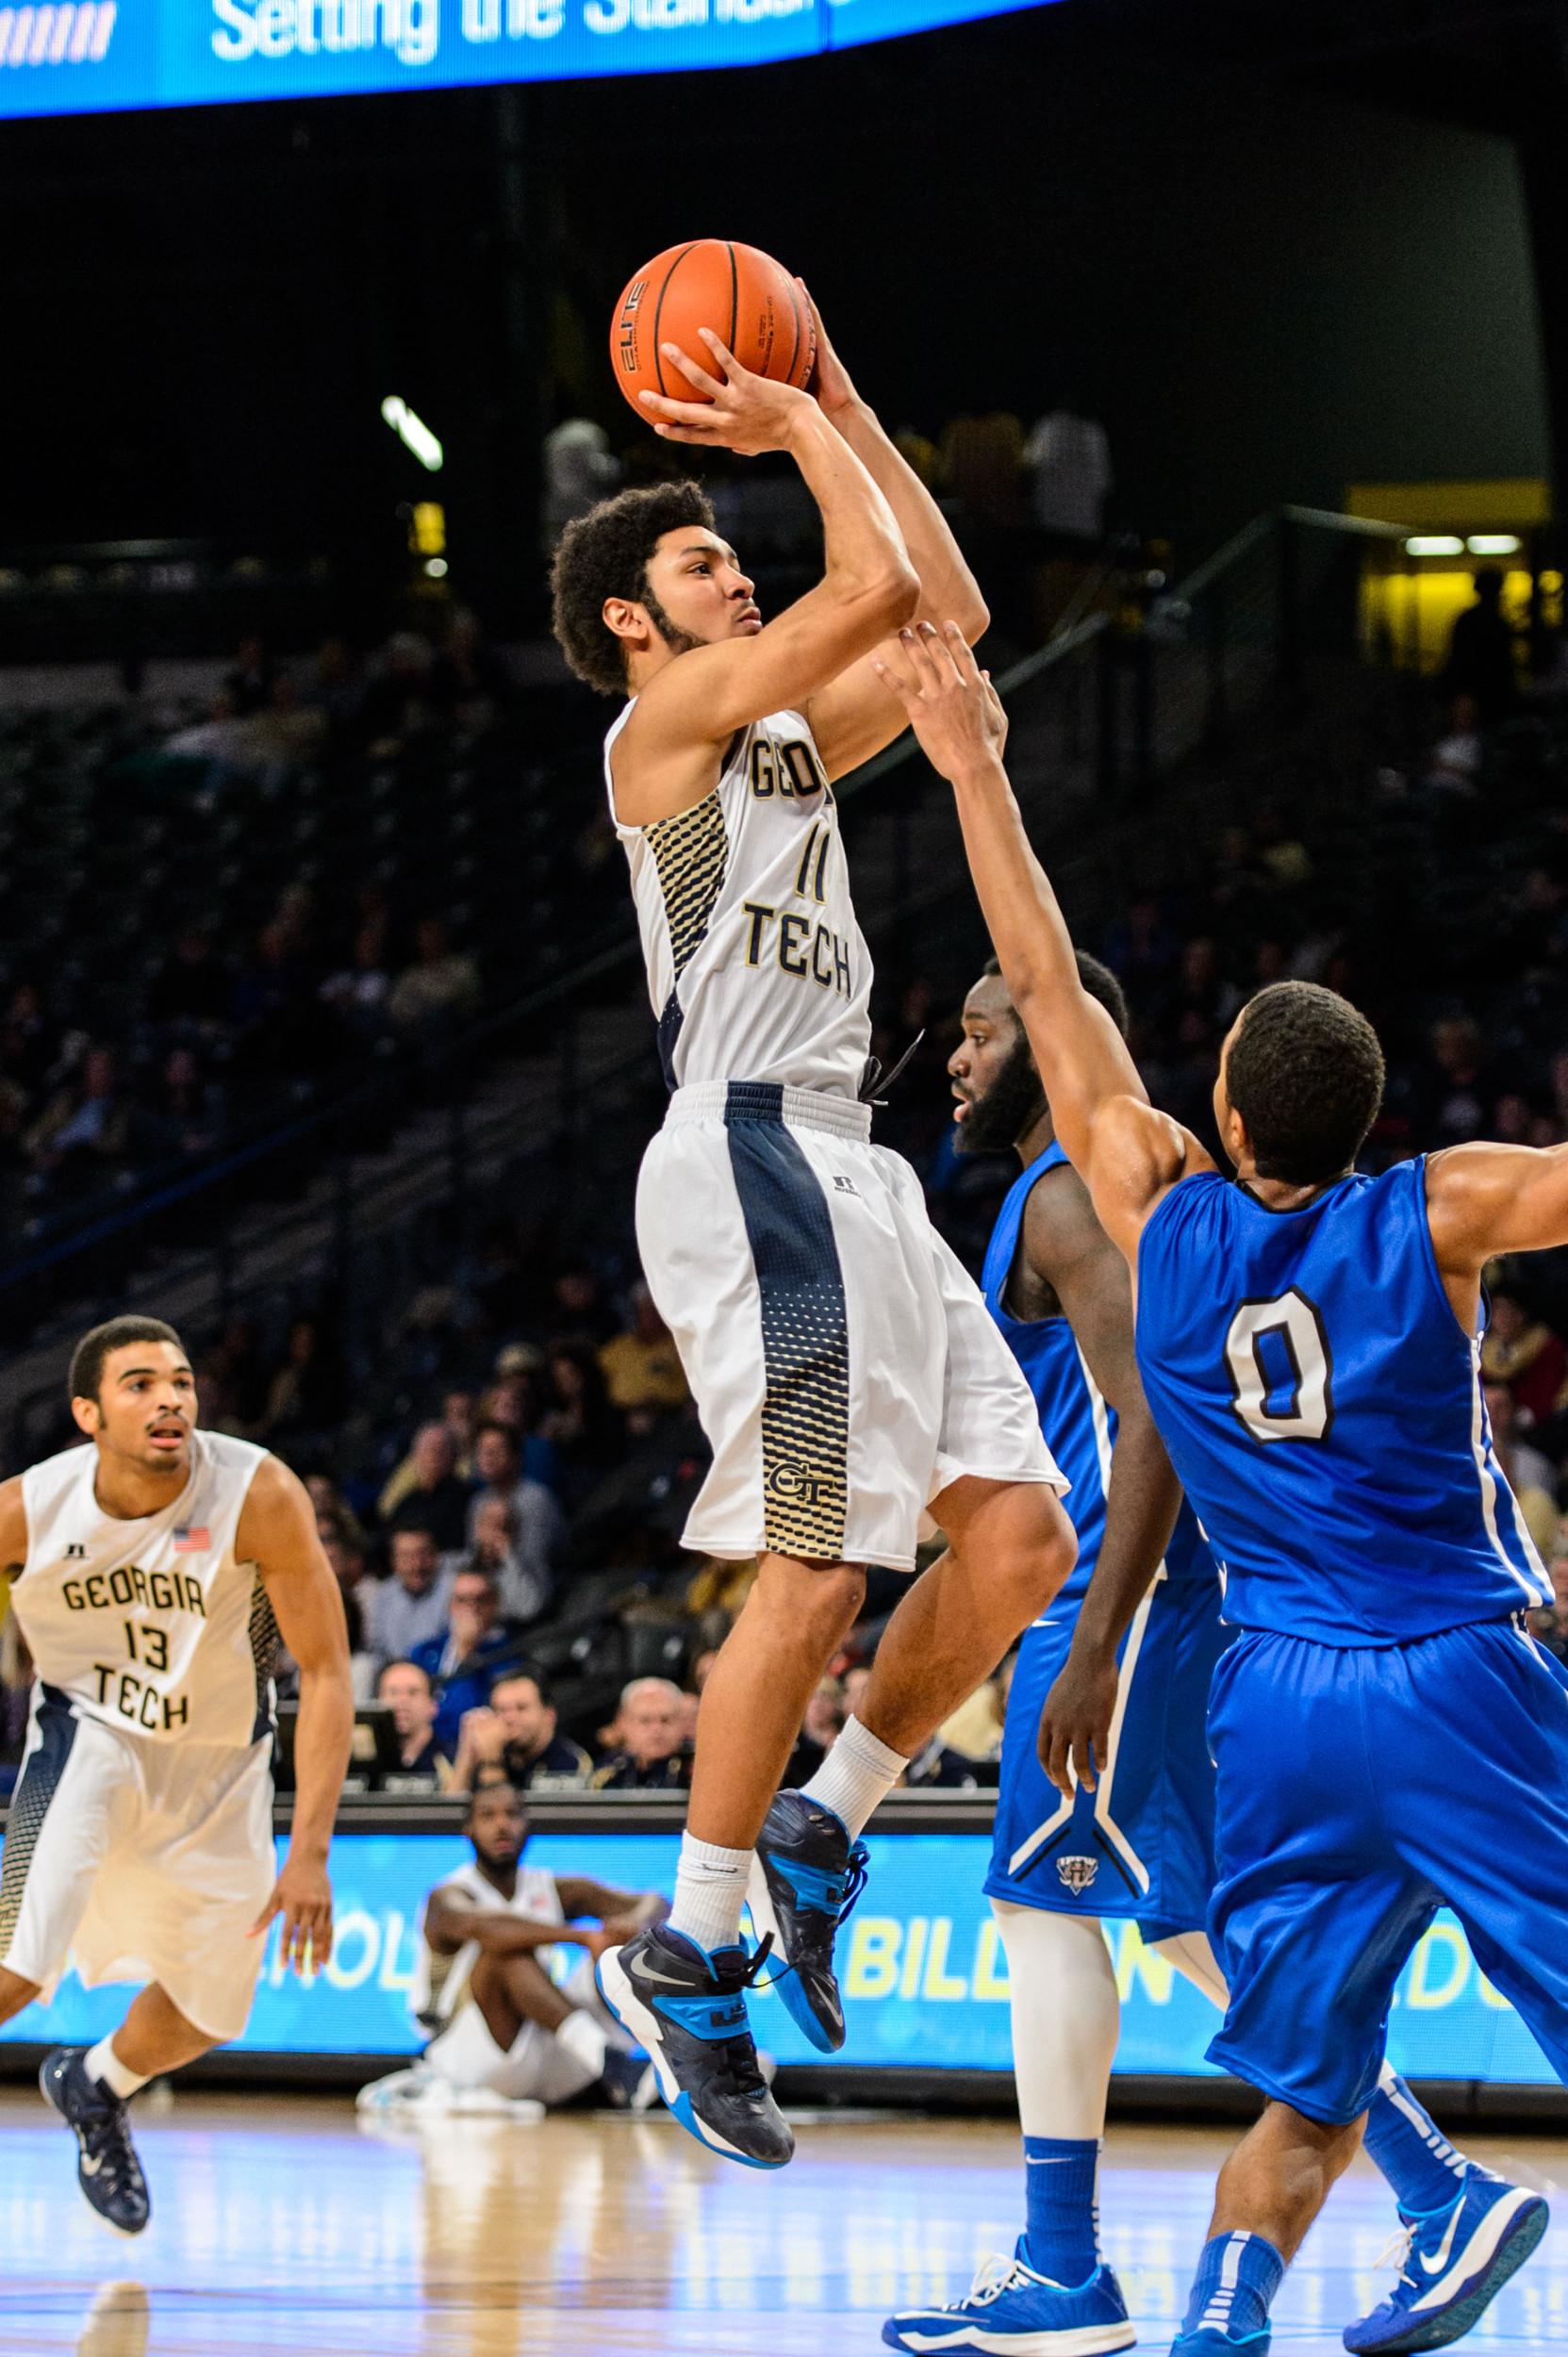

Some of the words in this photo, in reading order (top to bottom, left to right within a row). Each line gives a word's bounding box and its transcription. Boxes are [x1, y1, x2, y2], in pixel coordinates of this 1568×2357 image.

[619, 280, 647, 371] ELITE
[793, 818, 831, 907] 11
[742, 900, 852, 1003] TECH
[1222, 1283, 1336, 1447] 0
[767, 1461, 835, 1507] GT
[61, 1564, 207, 1618] GEORGIA
[123, 1619, 170, 1673] 13
[93, 1662, 189, 1731] TECH
